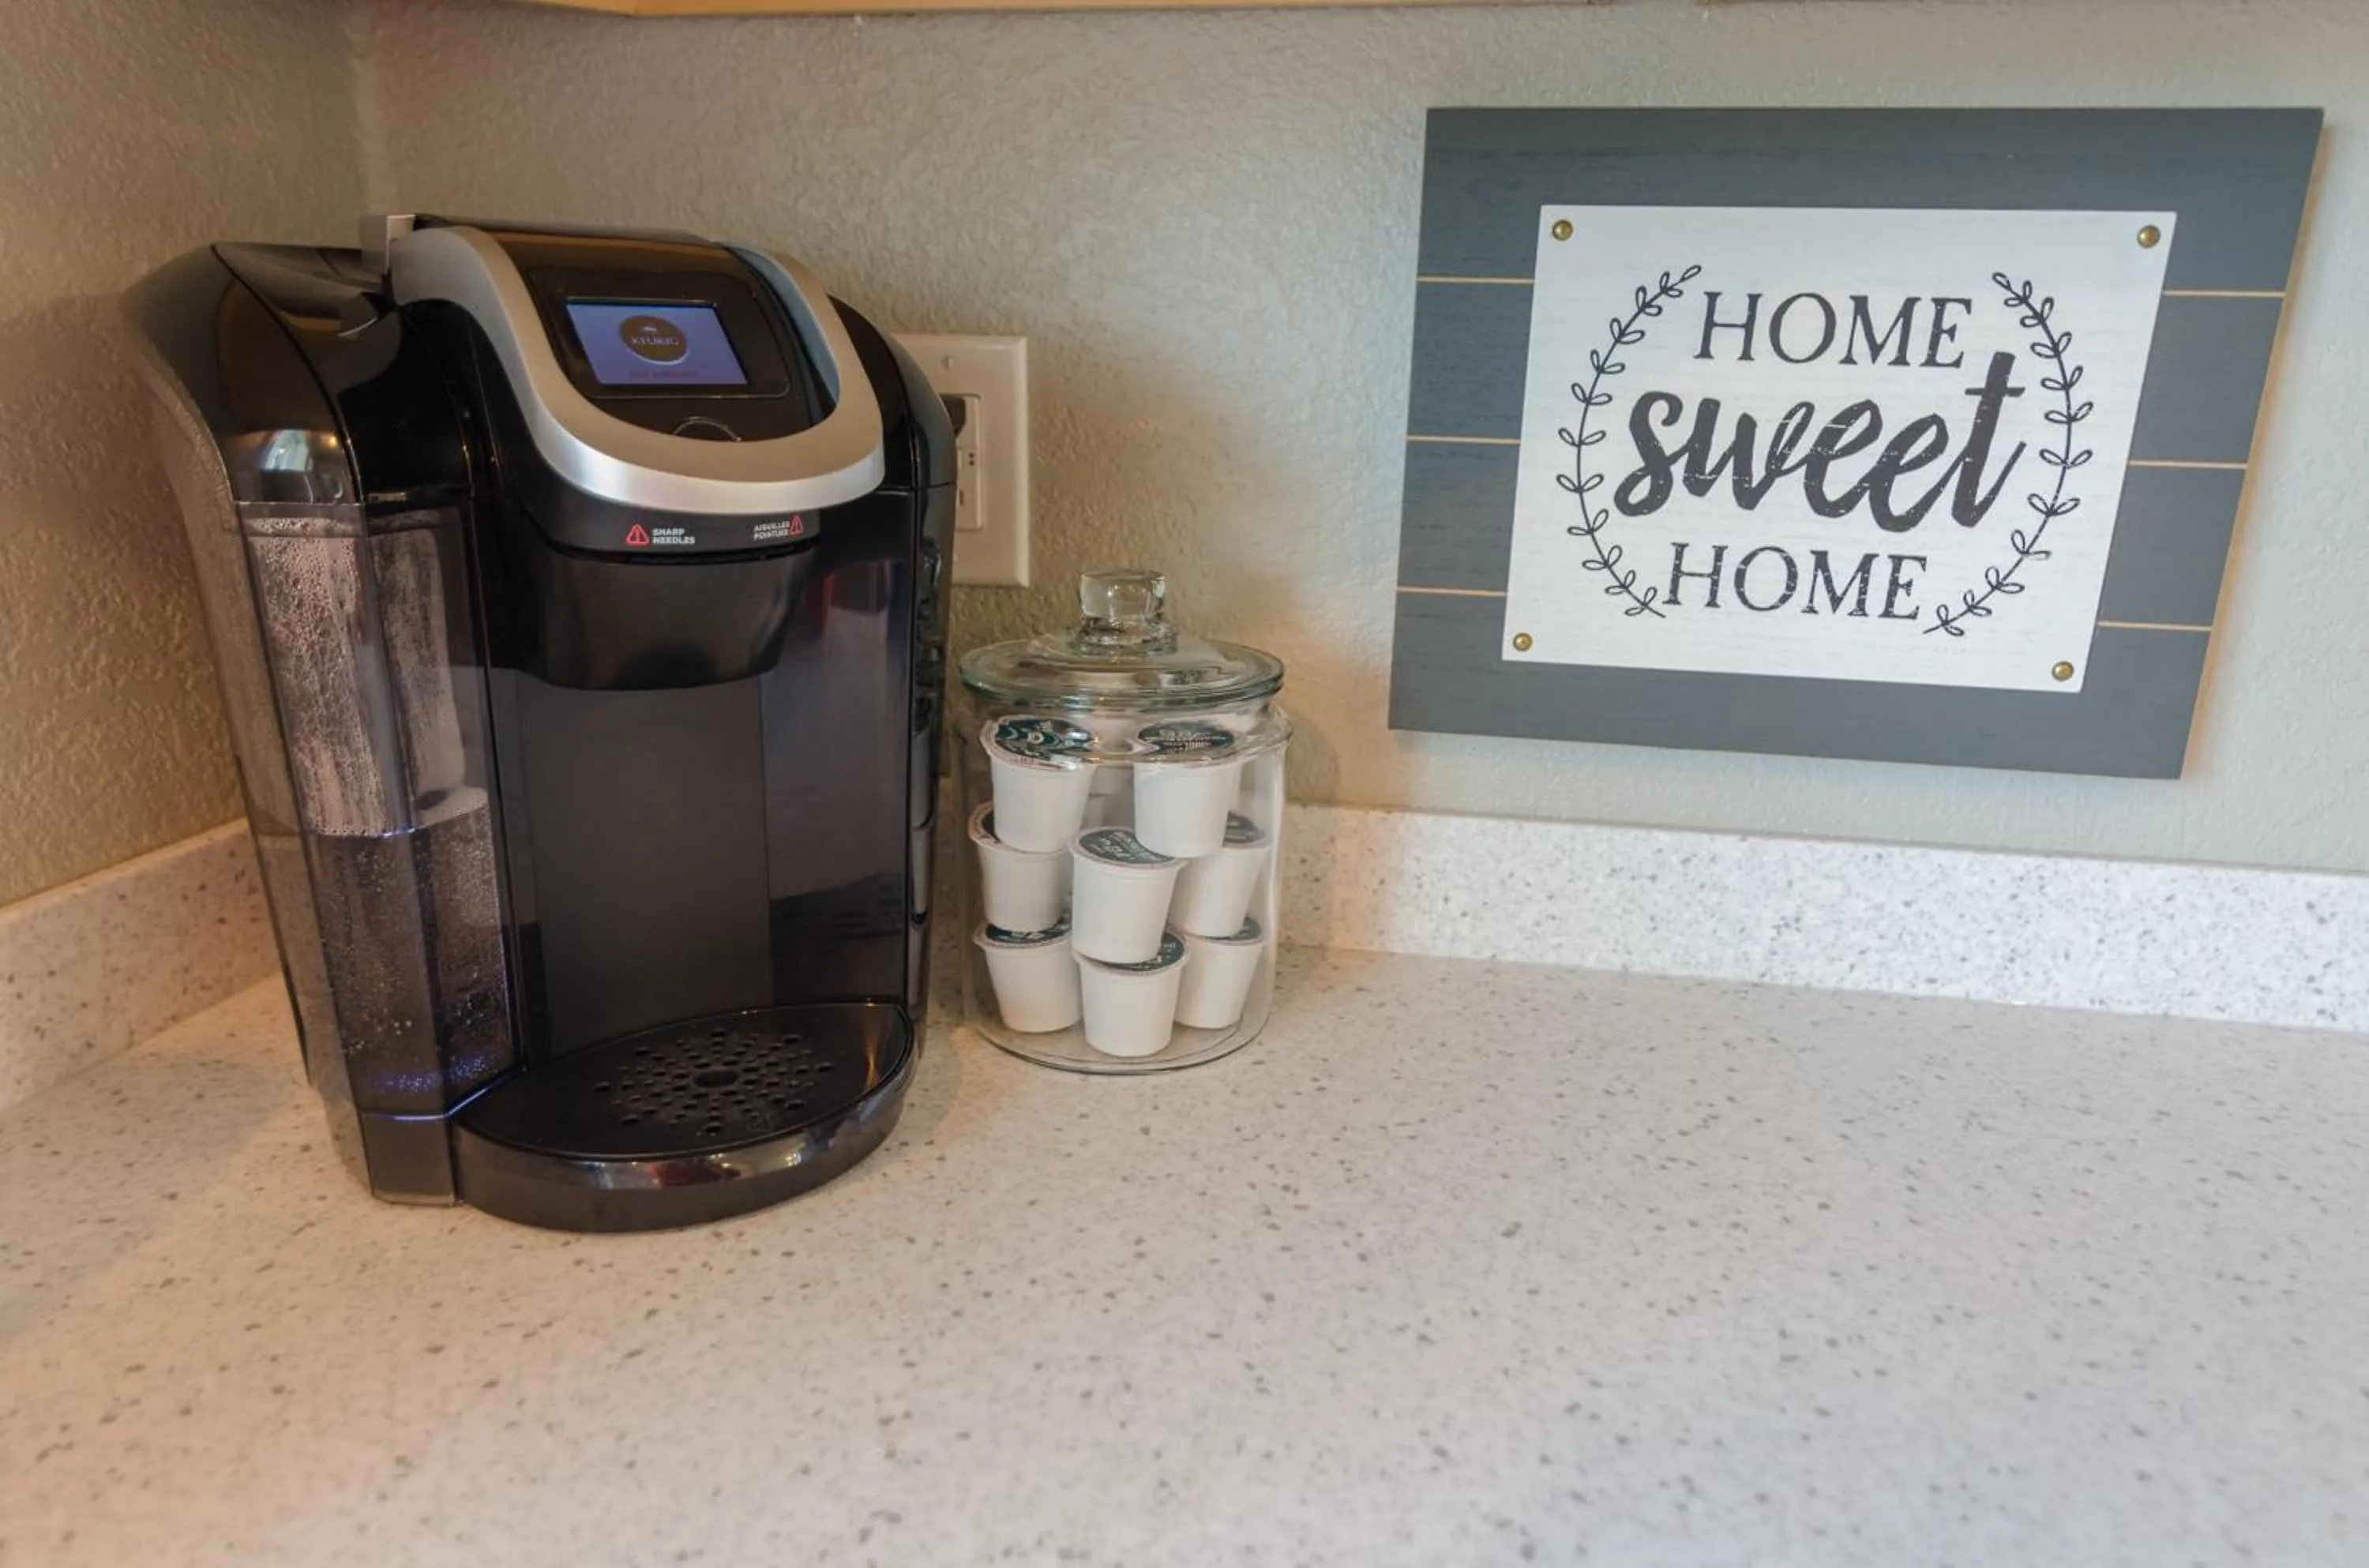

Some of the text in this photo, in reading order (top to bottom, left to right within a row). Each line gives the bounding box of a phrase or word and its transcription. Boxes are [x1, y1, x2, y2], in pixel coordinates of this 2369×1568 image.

[1693, 291, 1973, 369] HOME
[1613, 351, 2027, 534] sweet
[1661, 542, 1928, 621] HOME
